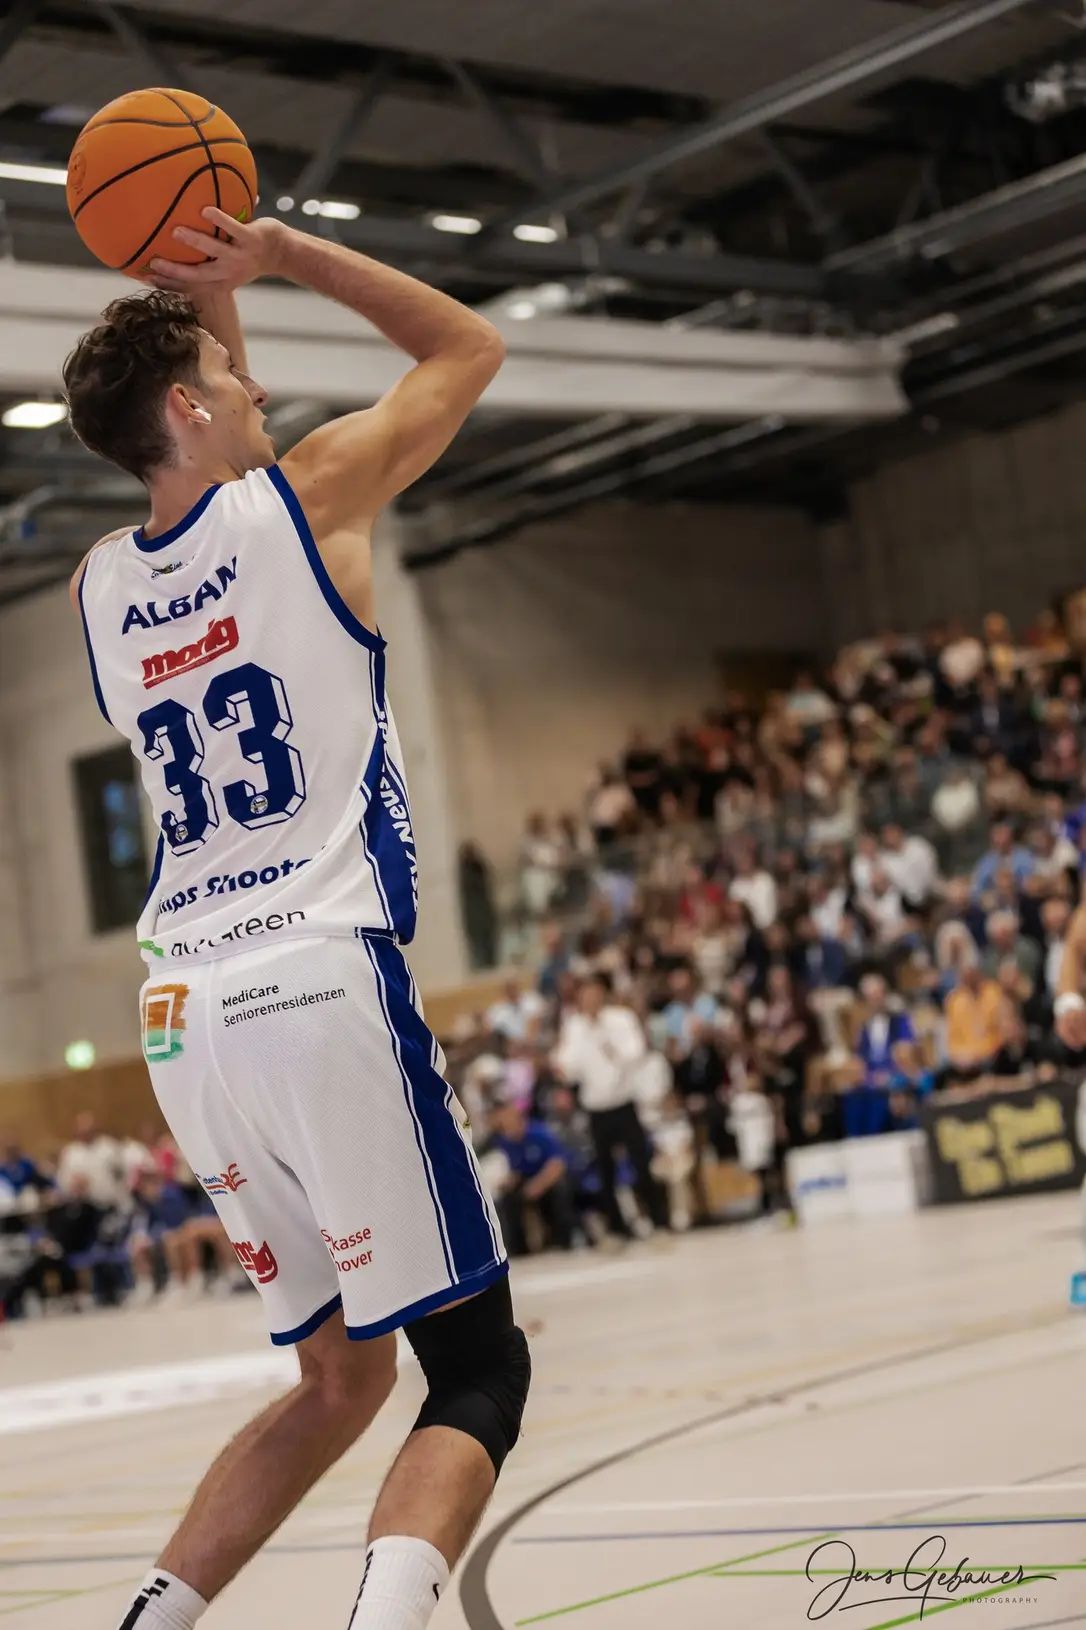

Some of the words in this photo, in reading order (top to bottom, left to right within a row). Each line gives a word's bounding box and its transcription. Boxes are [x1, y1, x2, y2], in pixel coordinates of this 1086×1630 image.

[121, 556, 238, 635] ALBAN
[136, 661, 307, 857] 33
[222, 983, 280, 1010] MediCare
[223, 986, 346, 1028] Seniorenresidenzen
